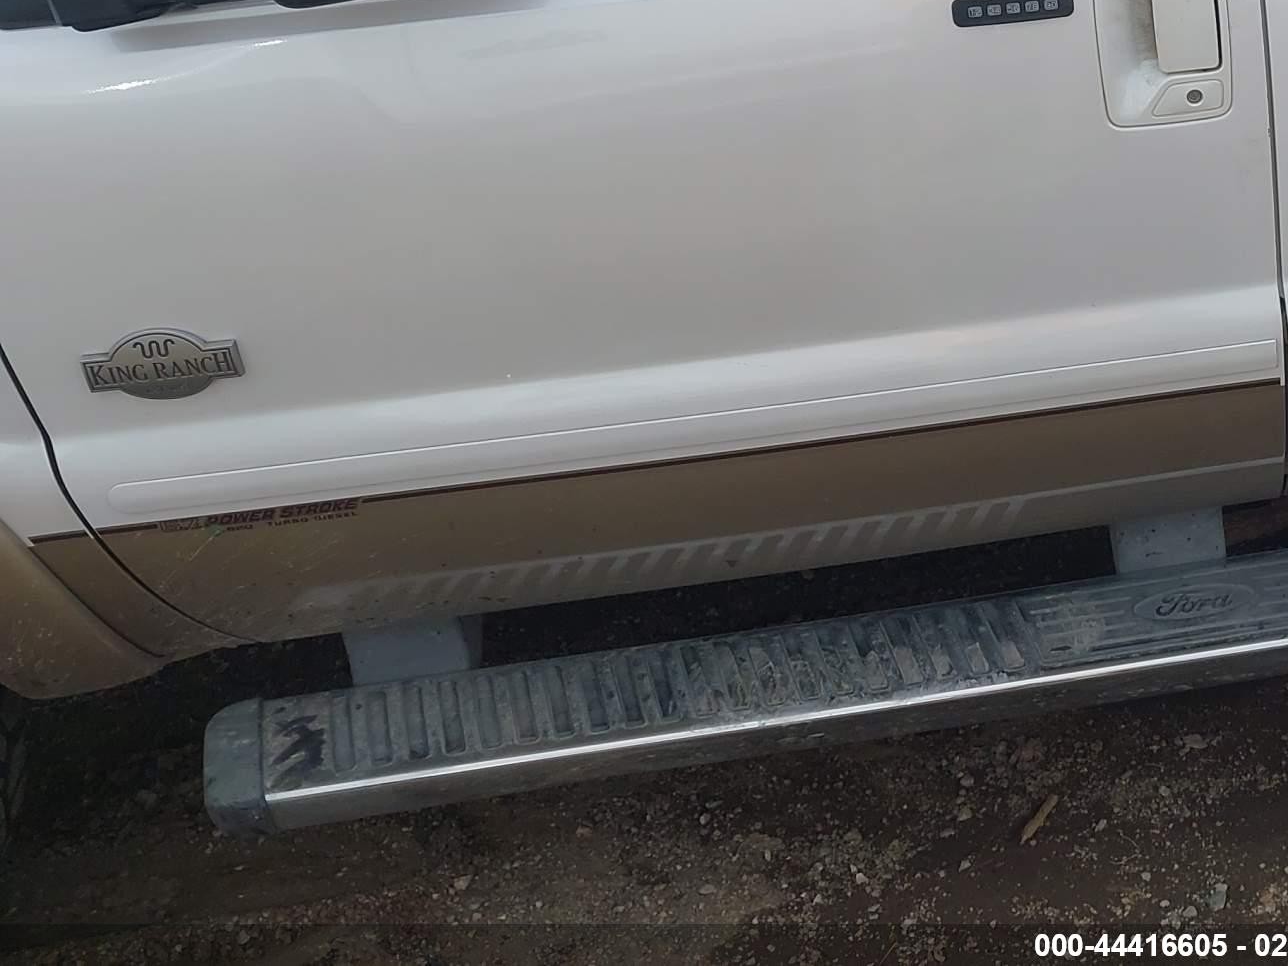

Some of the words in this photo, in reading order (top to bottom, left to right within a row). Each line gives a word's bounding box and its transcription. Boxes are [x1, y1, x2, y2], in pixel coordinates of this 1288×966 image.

[89, 364, 148, 386] KING
[152, 351, 232, 380] RANCH
[206, 508, 274, 525] POWER
[279, 497, 358, 518] STROKE
[1154, 591, 1234, 617] Ford
